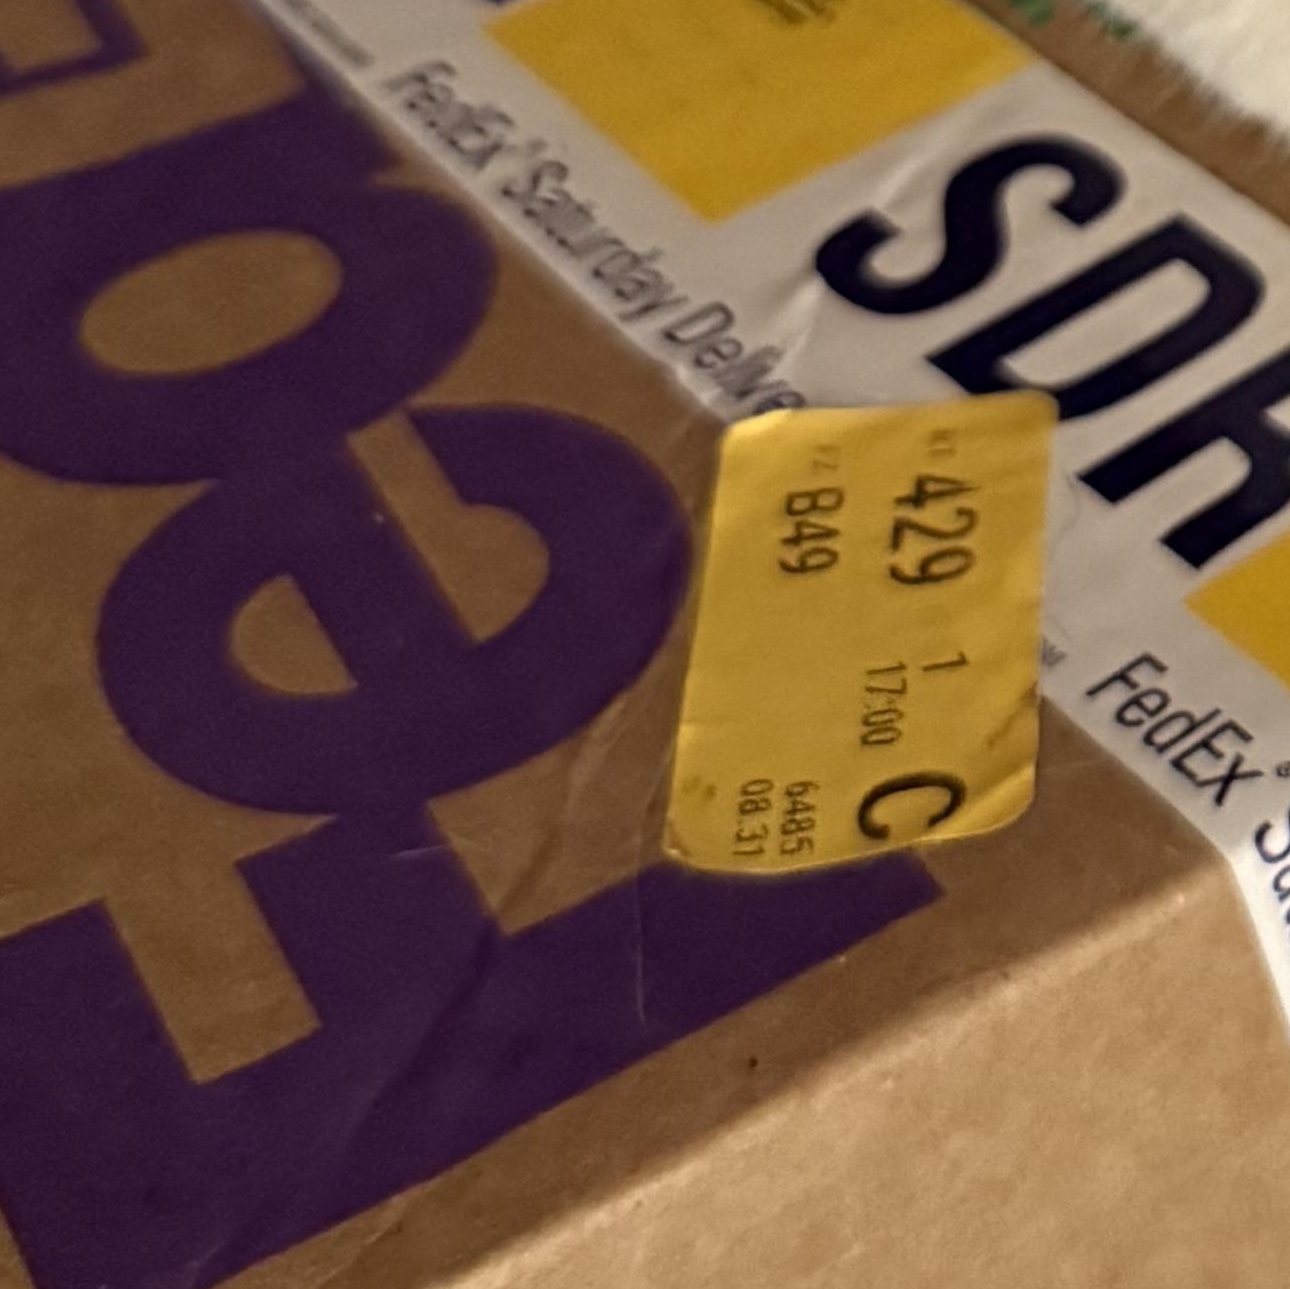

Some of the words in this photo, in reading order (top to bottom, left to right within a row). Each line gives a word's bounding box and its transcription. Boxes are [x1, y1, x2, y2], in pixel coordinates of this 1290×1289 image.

[663, 301, 806, 417] Delive
[889, 472, 982, 587] 429
[860, 660, 909, 748] 17:00
[780, 780, 820, 857] 6485
[857, 770, 967, 841] C
